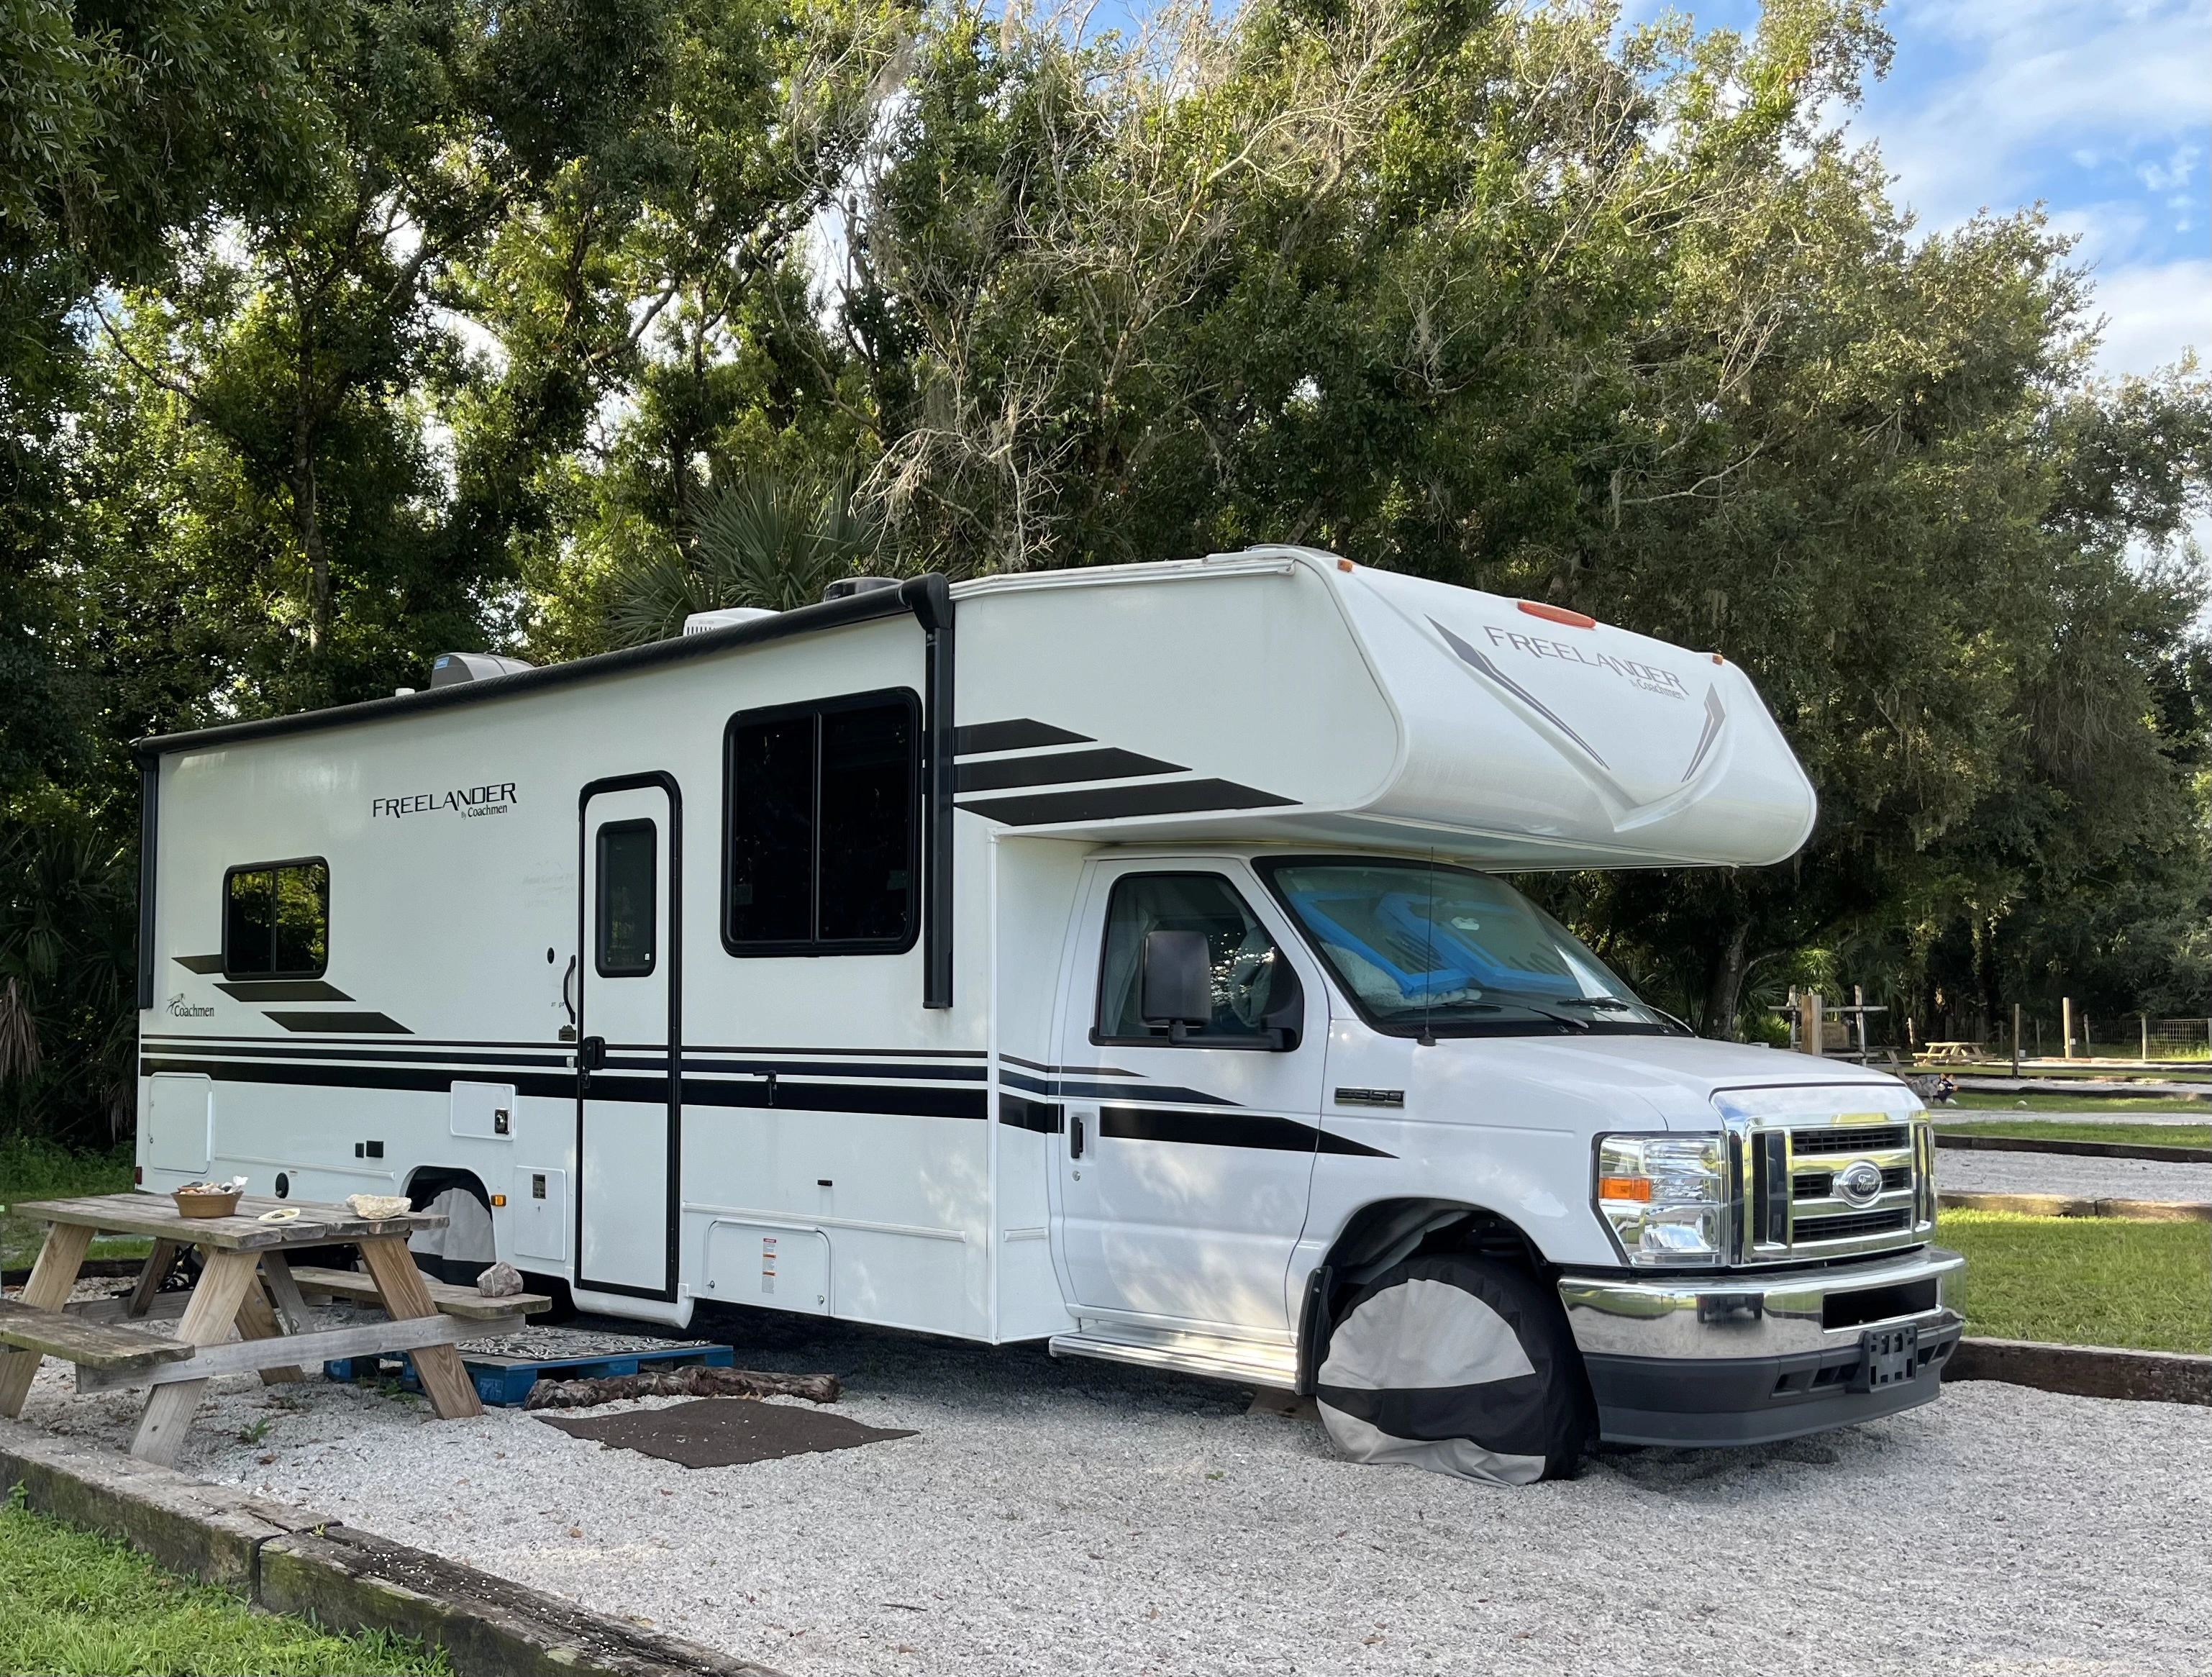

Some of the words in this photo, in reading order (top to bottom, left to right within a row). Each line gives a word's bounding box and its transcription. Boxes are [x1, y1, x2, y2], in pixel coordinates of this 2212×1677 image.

[1483, 624, 1690, 696] FREELANDER
[1637, 678, 1685, 701] Coachmen
[372, 782, 517, 819] FREELANDER
[467, 804, 508, 818] Coachmen
[174, 1004, 214, 1017] Coachmen
[1857, 1174, 1876, 1191] Ford
